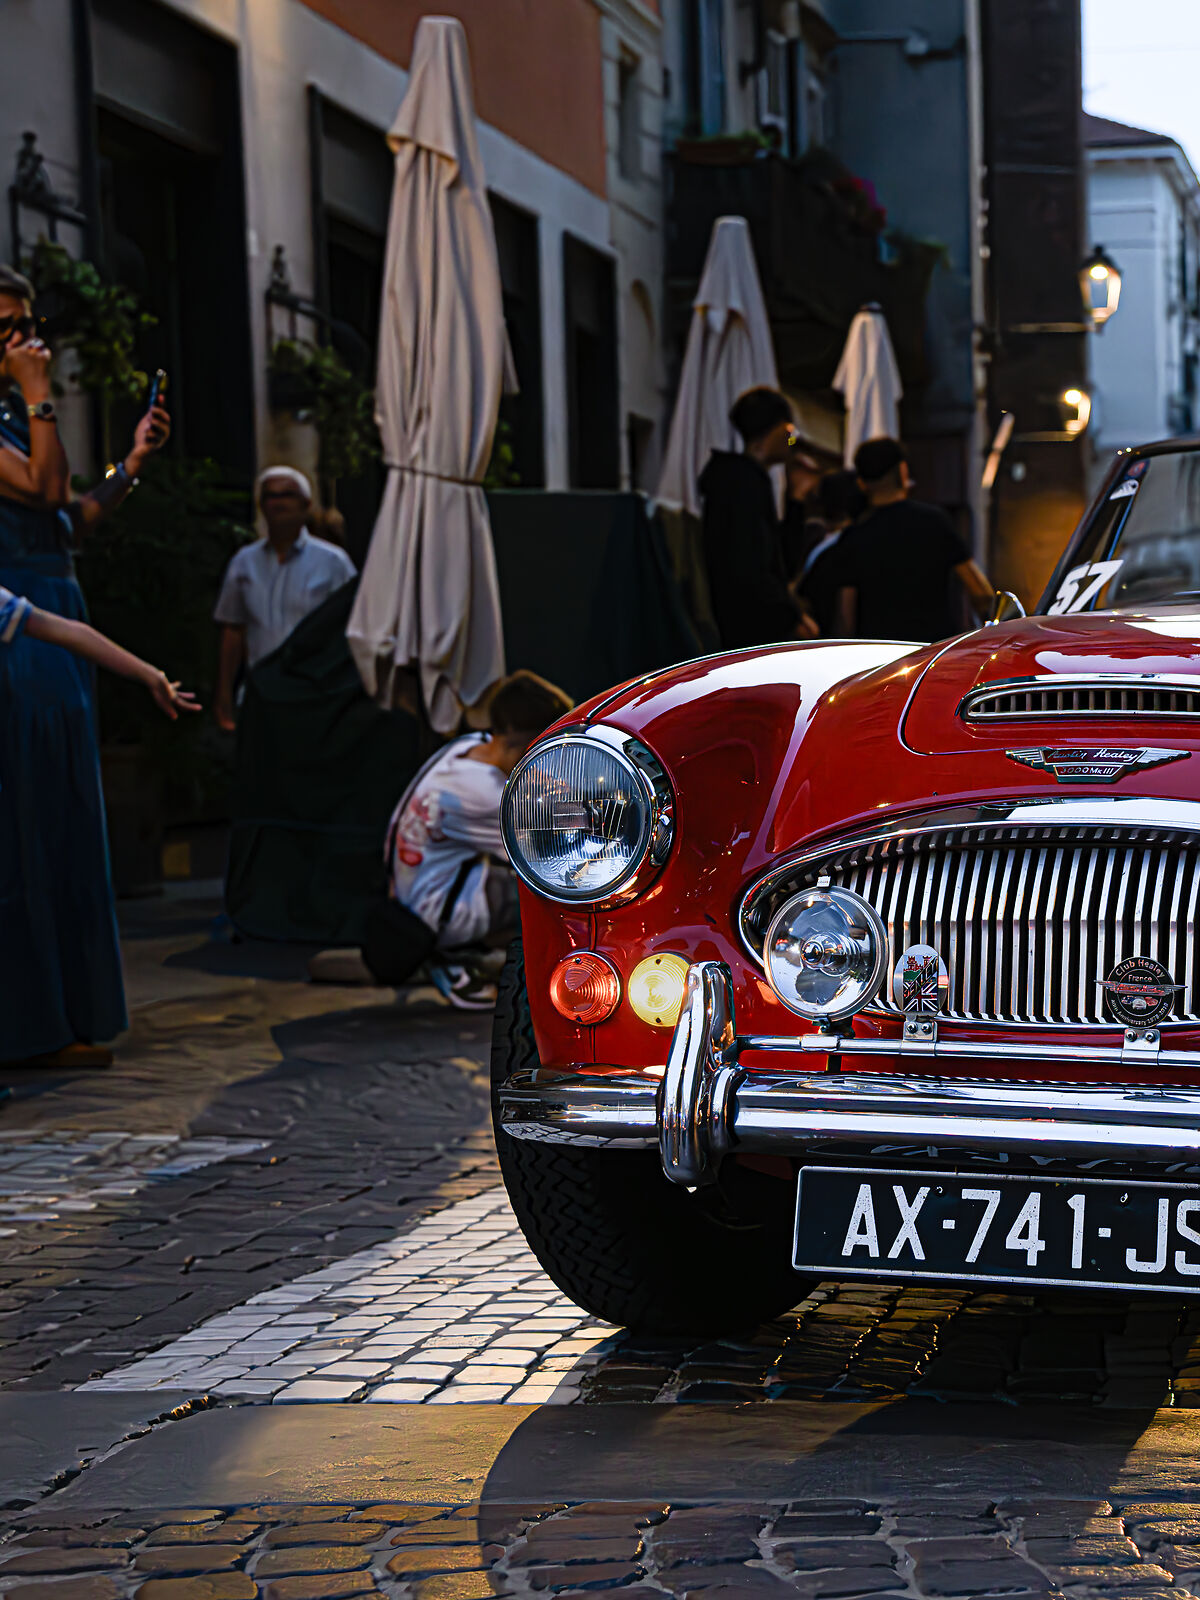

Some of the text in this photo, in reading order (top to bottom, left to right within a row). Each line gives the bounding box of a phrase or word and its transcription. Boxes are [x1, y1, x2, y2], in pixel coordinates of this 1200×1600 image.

[1047, 559, 1124, 615] 57
[1093, 748, 1138, 761] Healey
[1115, 959, 1165, 977] Club Healey
